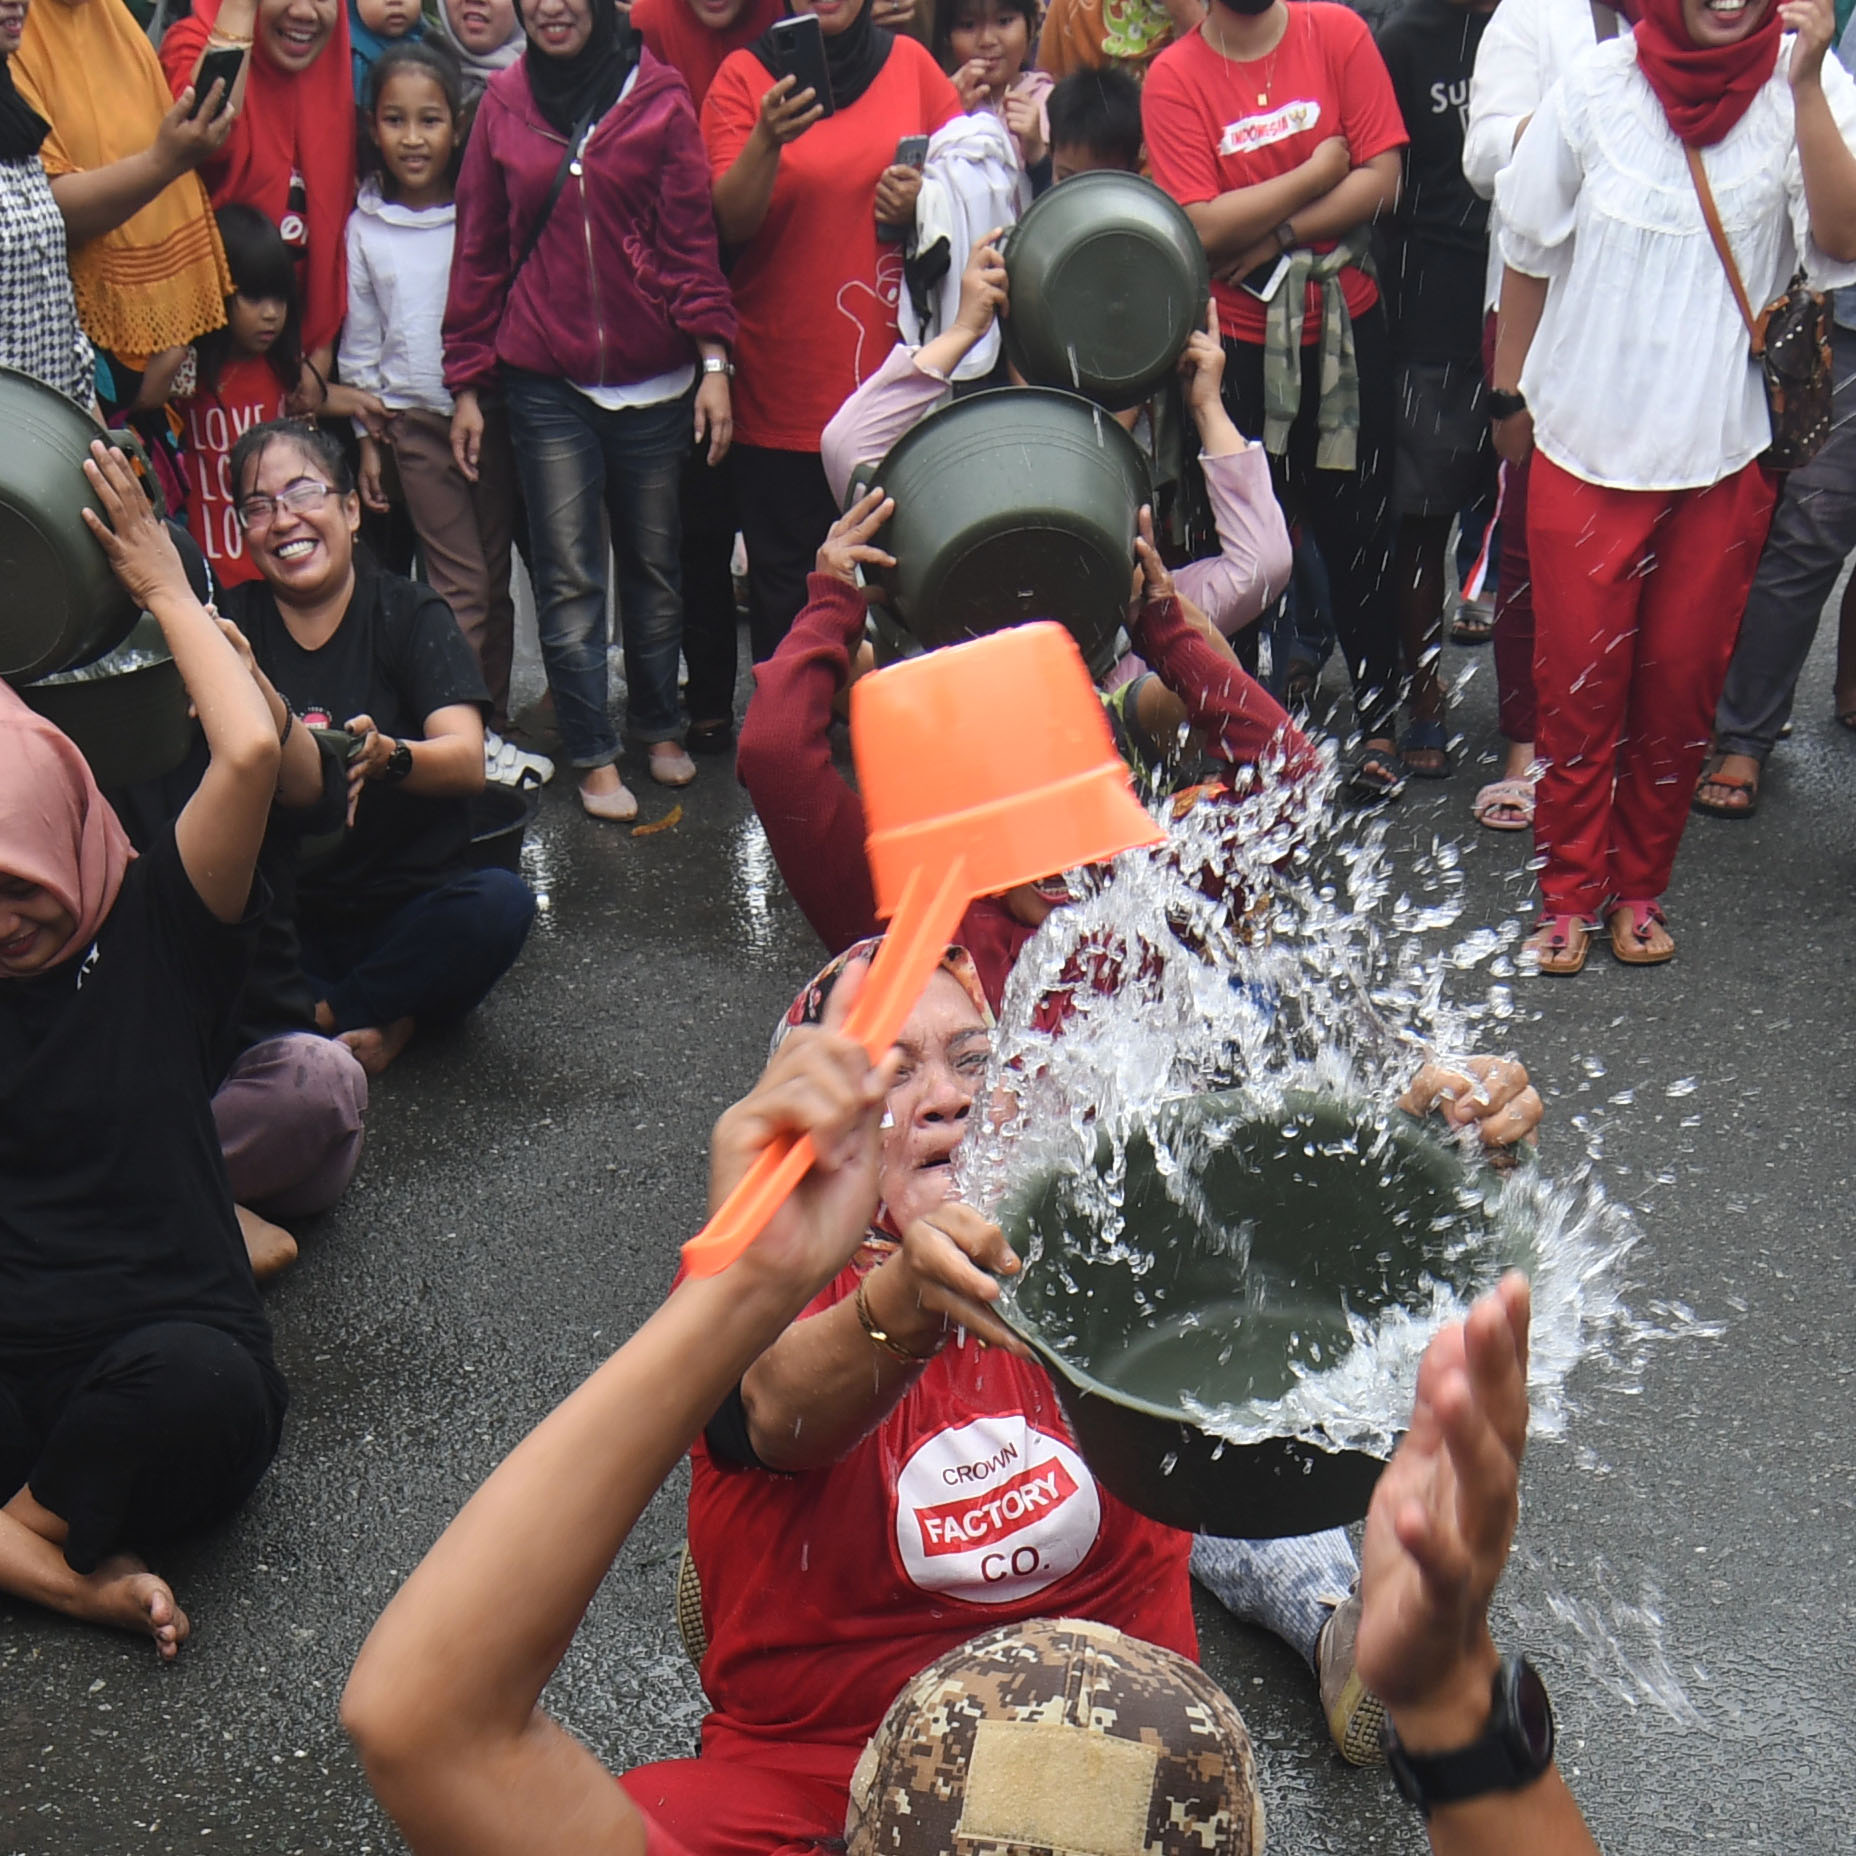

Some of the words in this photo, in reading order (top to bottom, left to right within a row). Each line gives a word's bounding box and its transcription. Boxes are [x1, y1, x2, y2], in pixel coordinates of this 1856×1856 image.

[202, 503, 243, 560] LO
[942, 1442, 1018, 1486] CROWN
[924, 1470, 1060, 1544] FACTORY
[981, 1546, 1050, 1583] CO.
